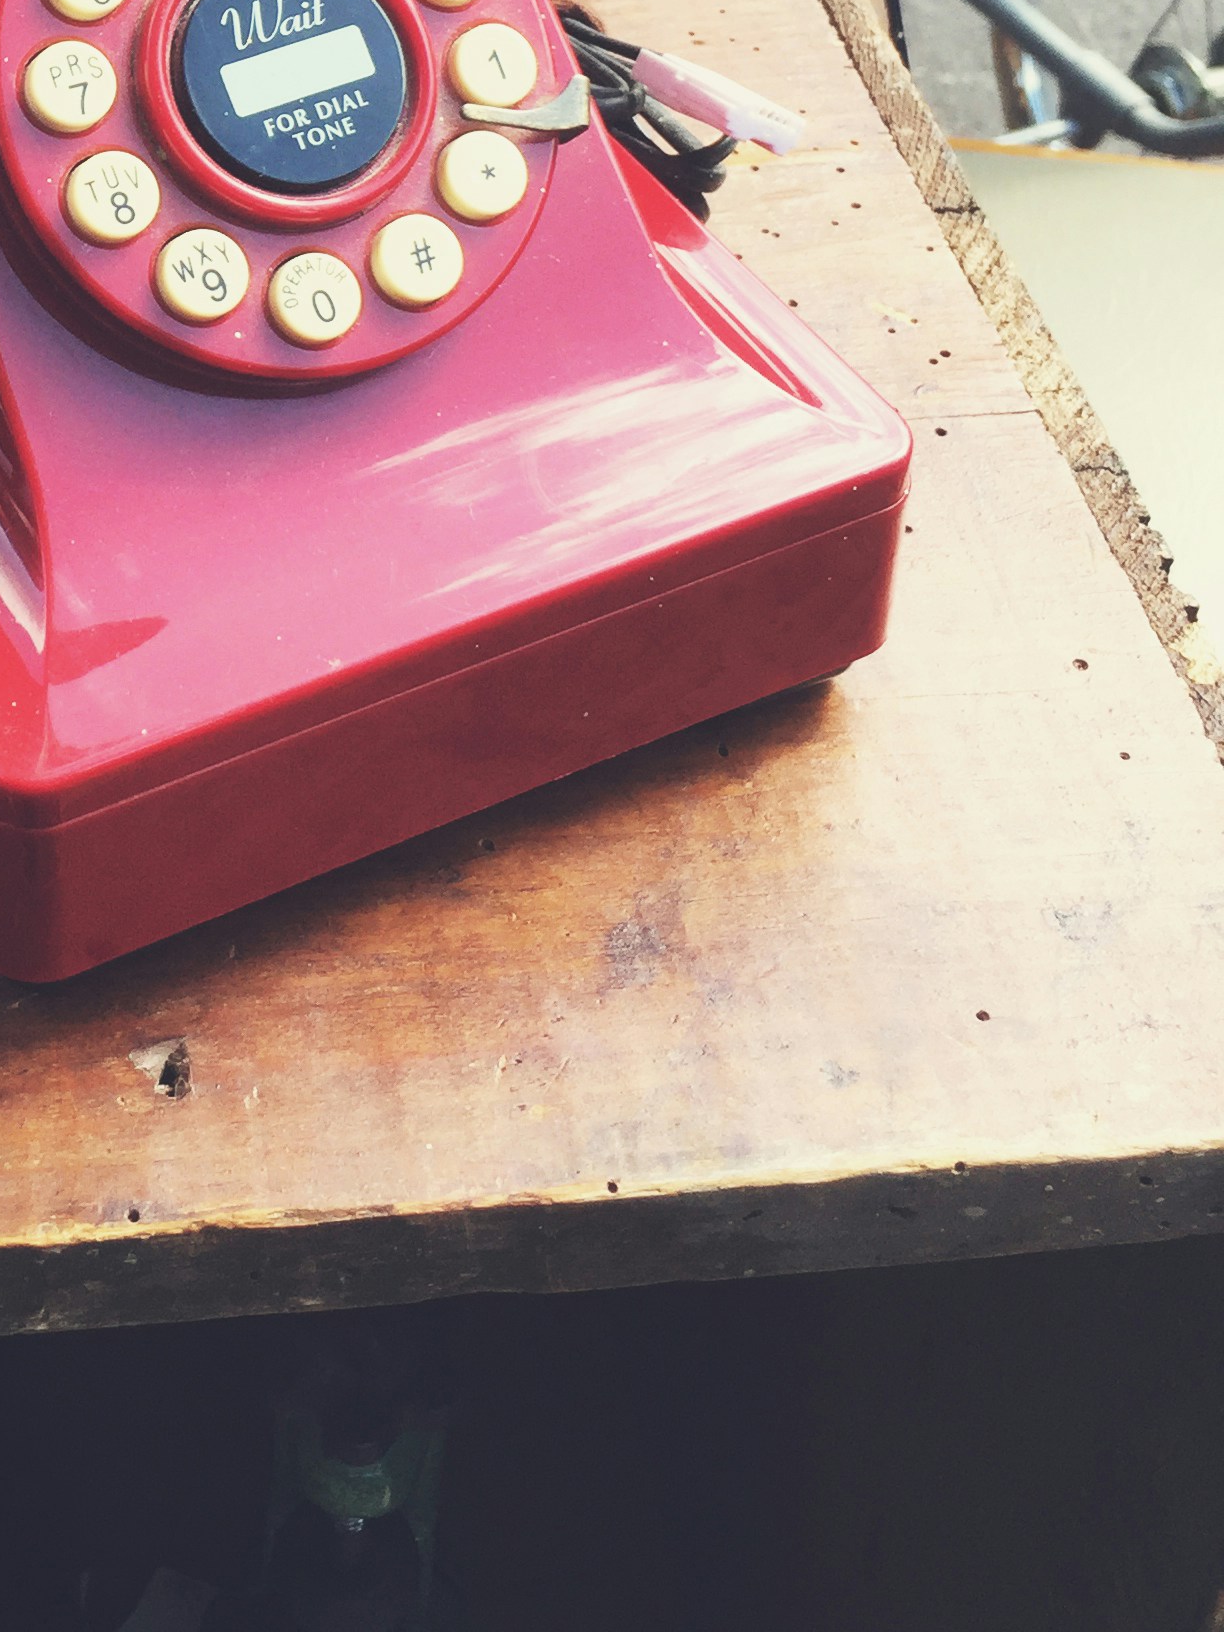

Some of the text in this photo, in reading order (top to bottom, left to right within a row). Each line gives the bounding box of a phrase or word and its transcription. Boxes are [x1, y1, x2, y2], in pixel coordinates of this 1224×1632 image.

[49, 54, 103, 88] PRS
[488, 50, 506, 79] 1
[68, 81, 88, 115] 7
[263, 90, 369, 137] FOR DIAL
[291, 116, 356, 150] TONE
[84, 165, 138, 202] TUV
[110, 192, 135, 224] 8
[172, 241, 229, 283] WXY
[202, 269, 227, 302] 9
[282, 257, 347, 309] OPERATOR
